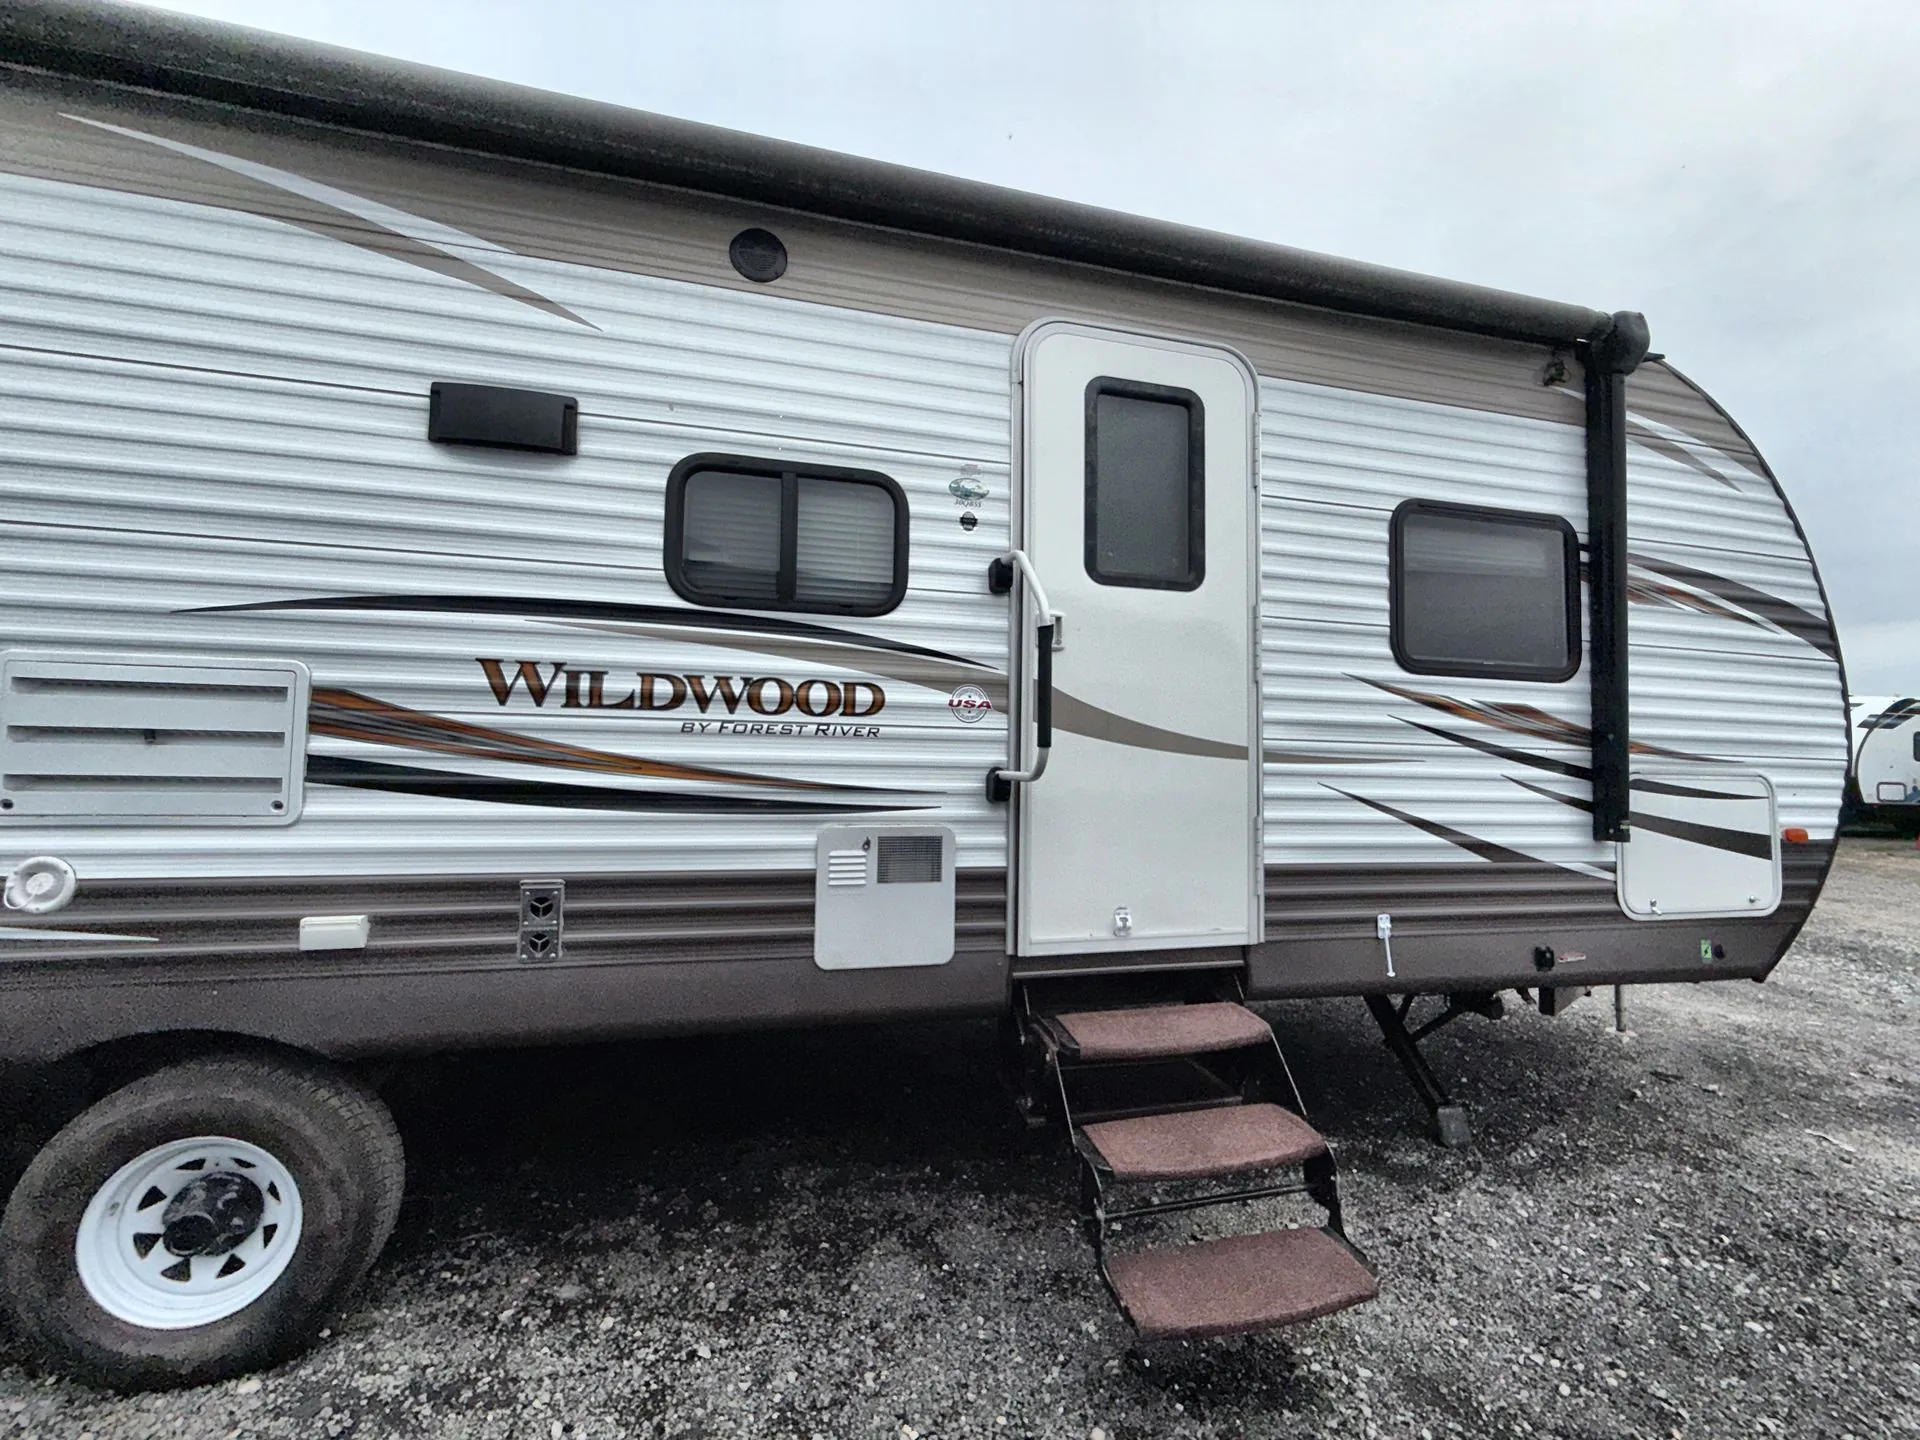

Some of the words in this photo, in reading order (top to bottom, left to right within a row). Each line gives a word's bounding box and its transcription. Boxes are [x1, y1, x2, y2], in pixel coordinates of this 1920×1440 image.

[475, 657, 886, 717] WILDWOOD
[948, 699, 992, 709] USA
[680, 722, 711, 734] BY
[718, 720, 808, 736] FOREST
[814, 723, 880, 738] RIVER
